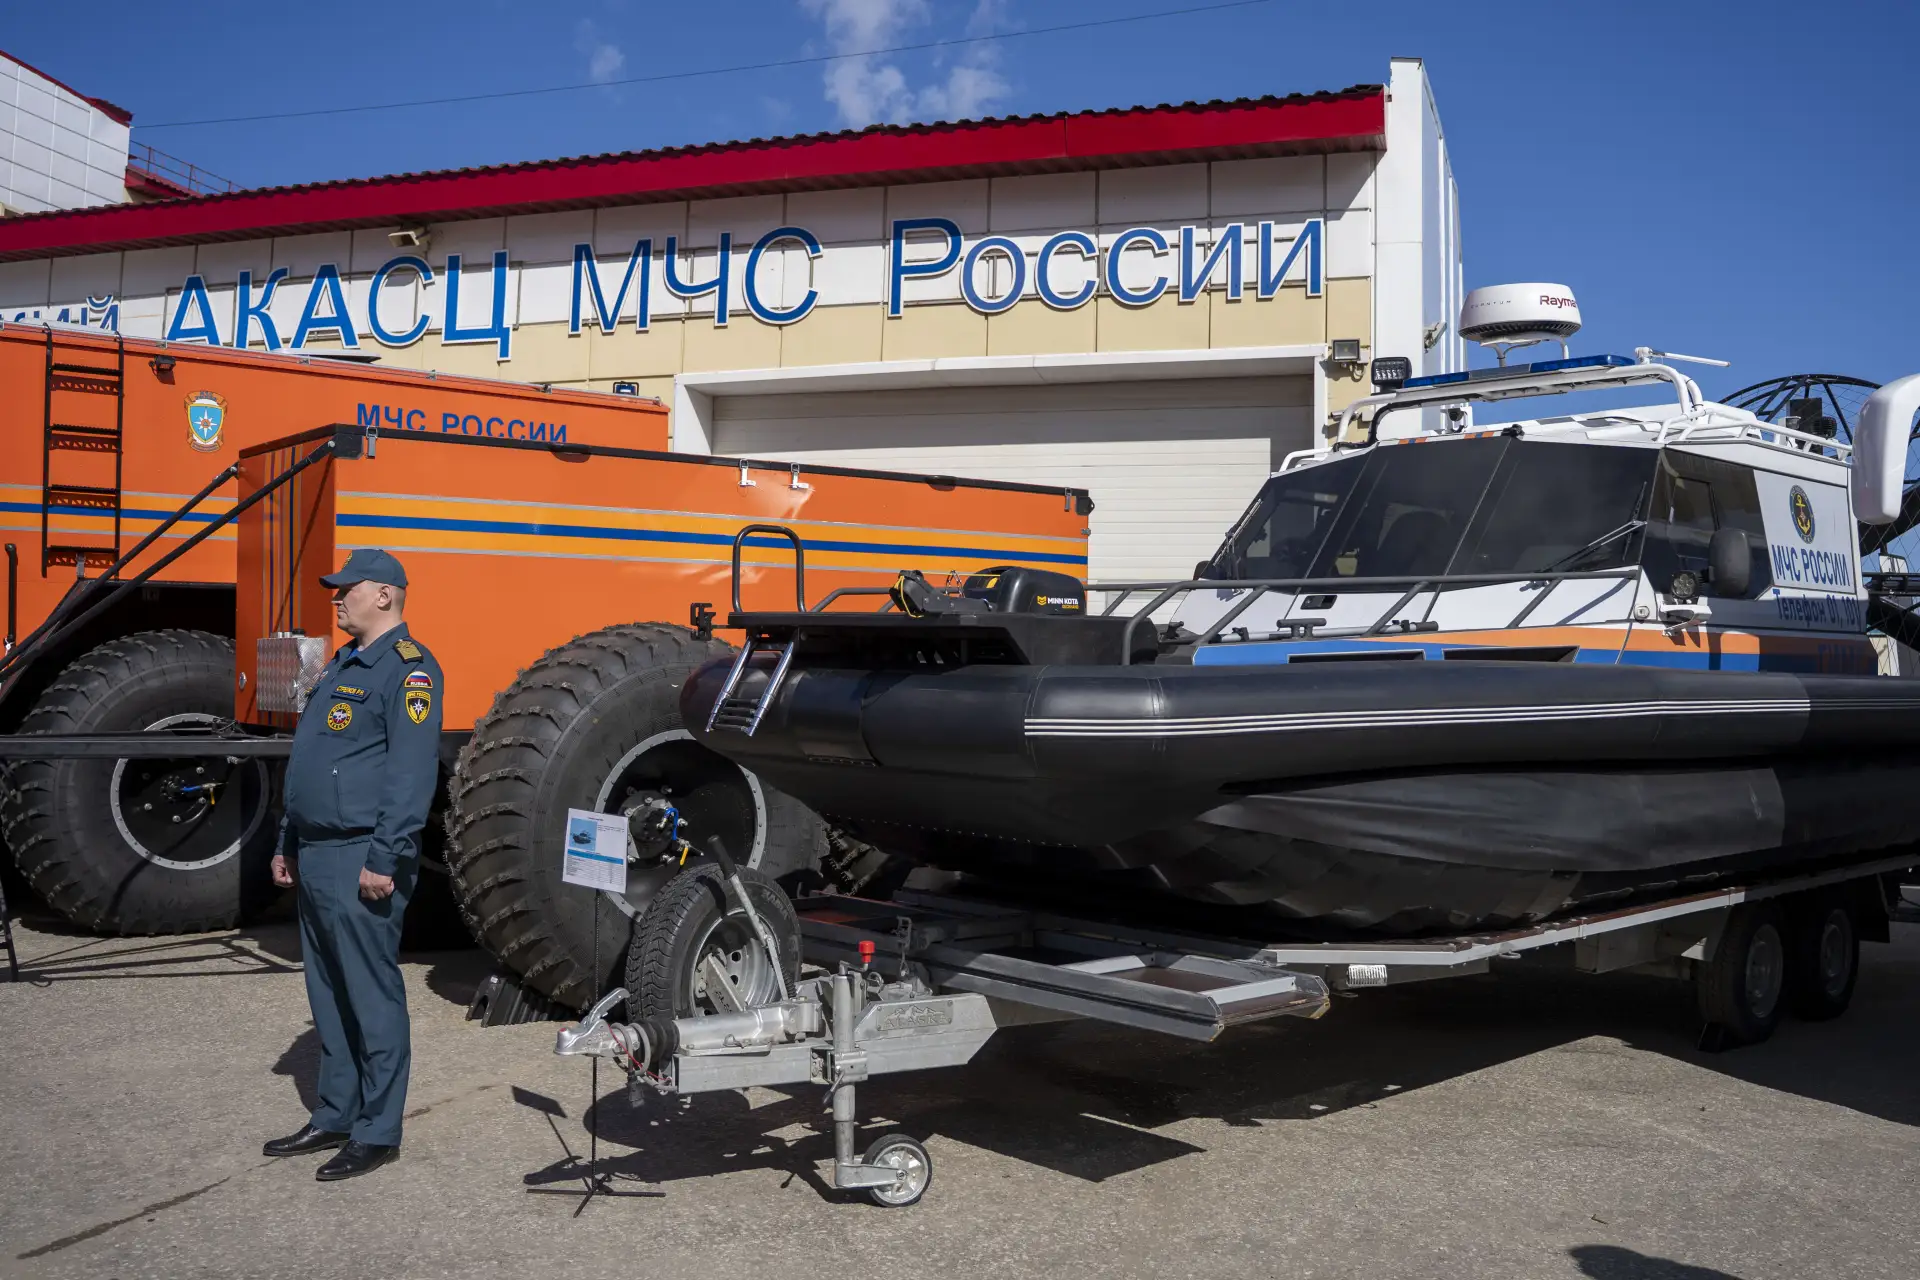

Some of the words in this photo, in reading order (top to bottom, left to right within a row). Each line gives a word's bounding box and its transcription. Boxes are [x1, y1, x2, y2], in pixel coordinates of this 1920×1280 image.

[166, 249, 512, 361] АКАСЦ
[568, 226, 823, 336] МЧС
[356, 402, 427, 430] МЧС
[442, 412, 567, 443] РОССИИ
[1771, 544, 1801, 581] МЧС
[1801, 548, 1851, 587] РОССИИ
[1772, 588, 1827, 628] Телефон
